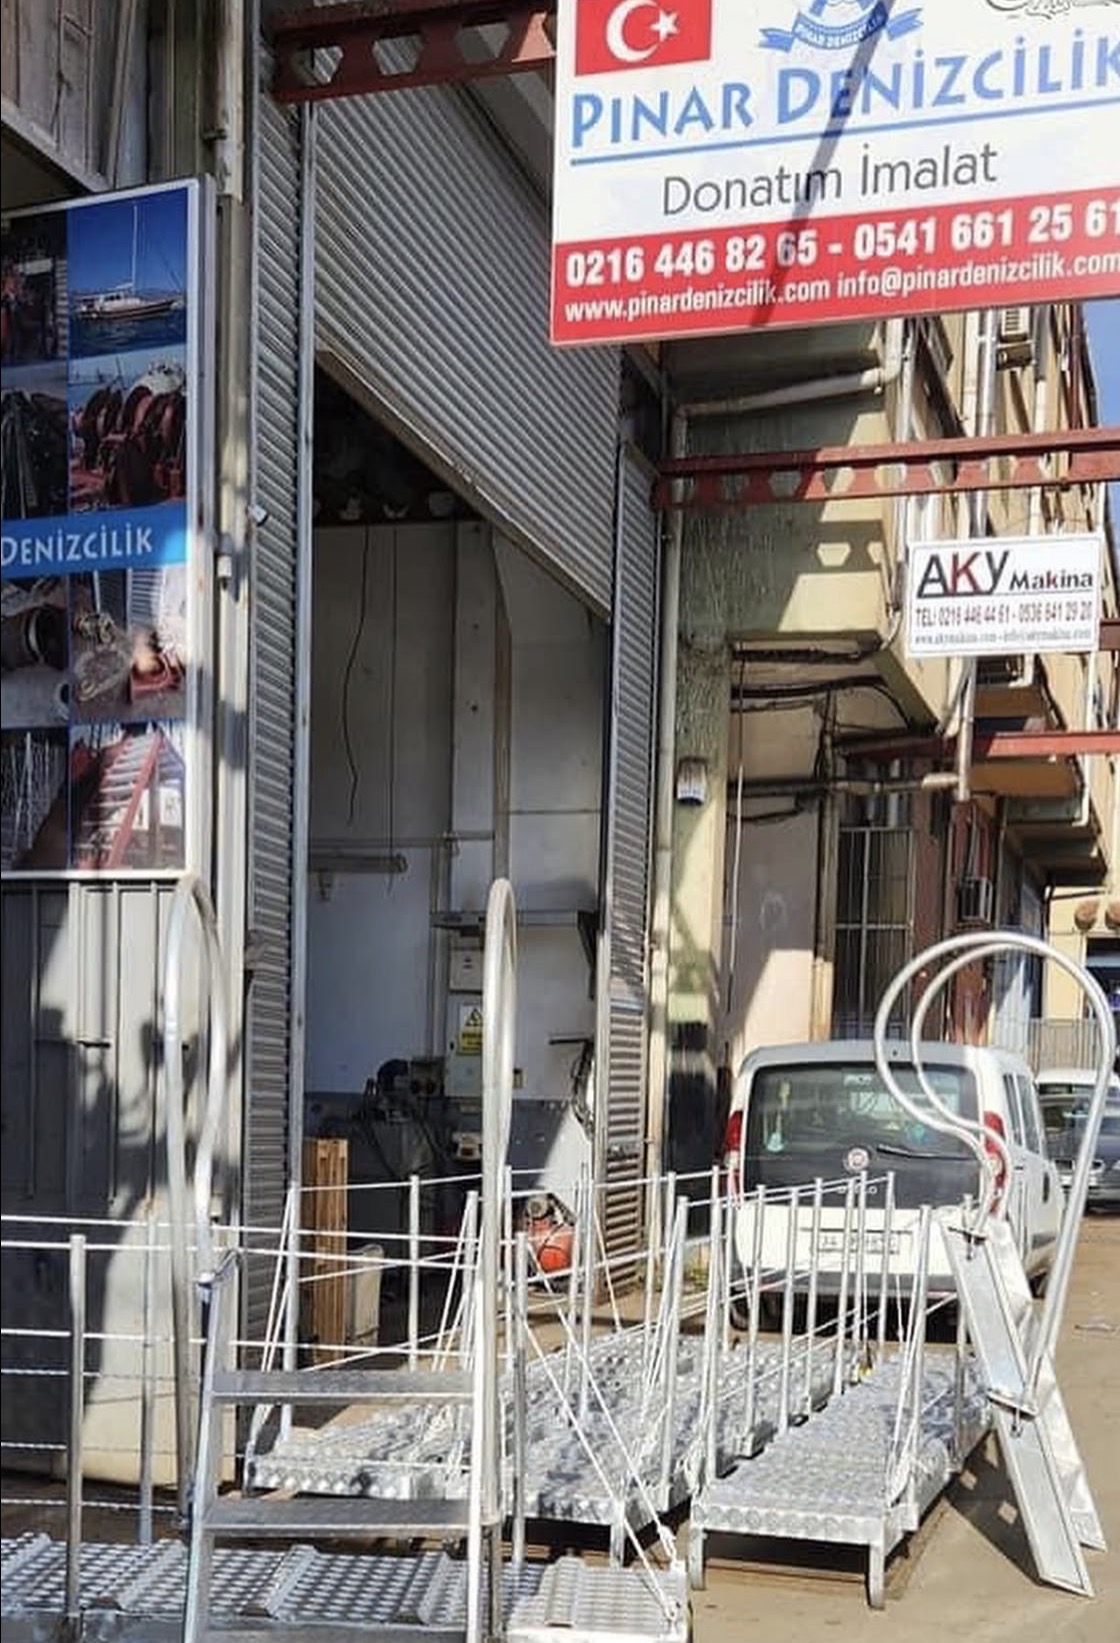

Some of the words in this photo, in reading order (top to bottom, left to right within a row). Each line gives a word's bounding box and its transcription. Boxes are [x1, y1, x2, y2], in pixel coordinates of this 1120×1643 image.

[572, 82, 753, 147] PINAR
[777, 28, 1120, 124] DENİZCİLİK
[663, 165, 842, 215] Donatım
[861, 143, 997, 196] İmalat
[566, 246, 645, 287] 0216
[654, 239, 715, 278] 446
[725, 234, 767, 272] 82
[776, 229, 818, 267] 65
[827, 242, 843, 254] -
[853, 216, 937, 260] 0541
[951, 209, 1013, 250] 661
[1027, 203, 1073, 243] 25
[1085, 197, 1120, 238] 61
[565, 278, 830, 322] www.pinardenizcilik.com
[837, 250, 1120, 298] info@pinardenizcilik.com
[1, 523, 152, 566] DENİZCİLİK
[917, 550, 1010, 599] AKY
[1009, 569, 1094, 591] Makina
